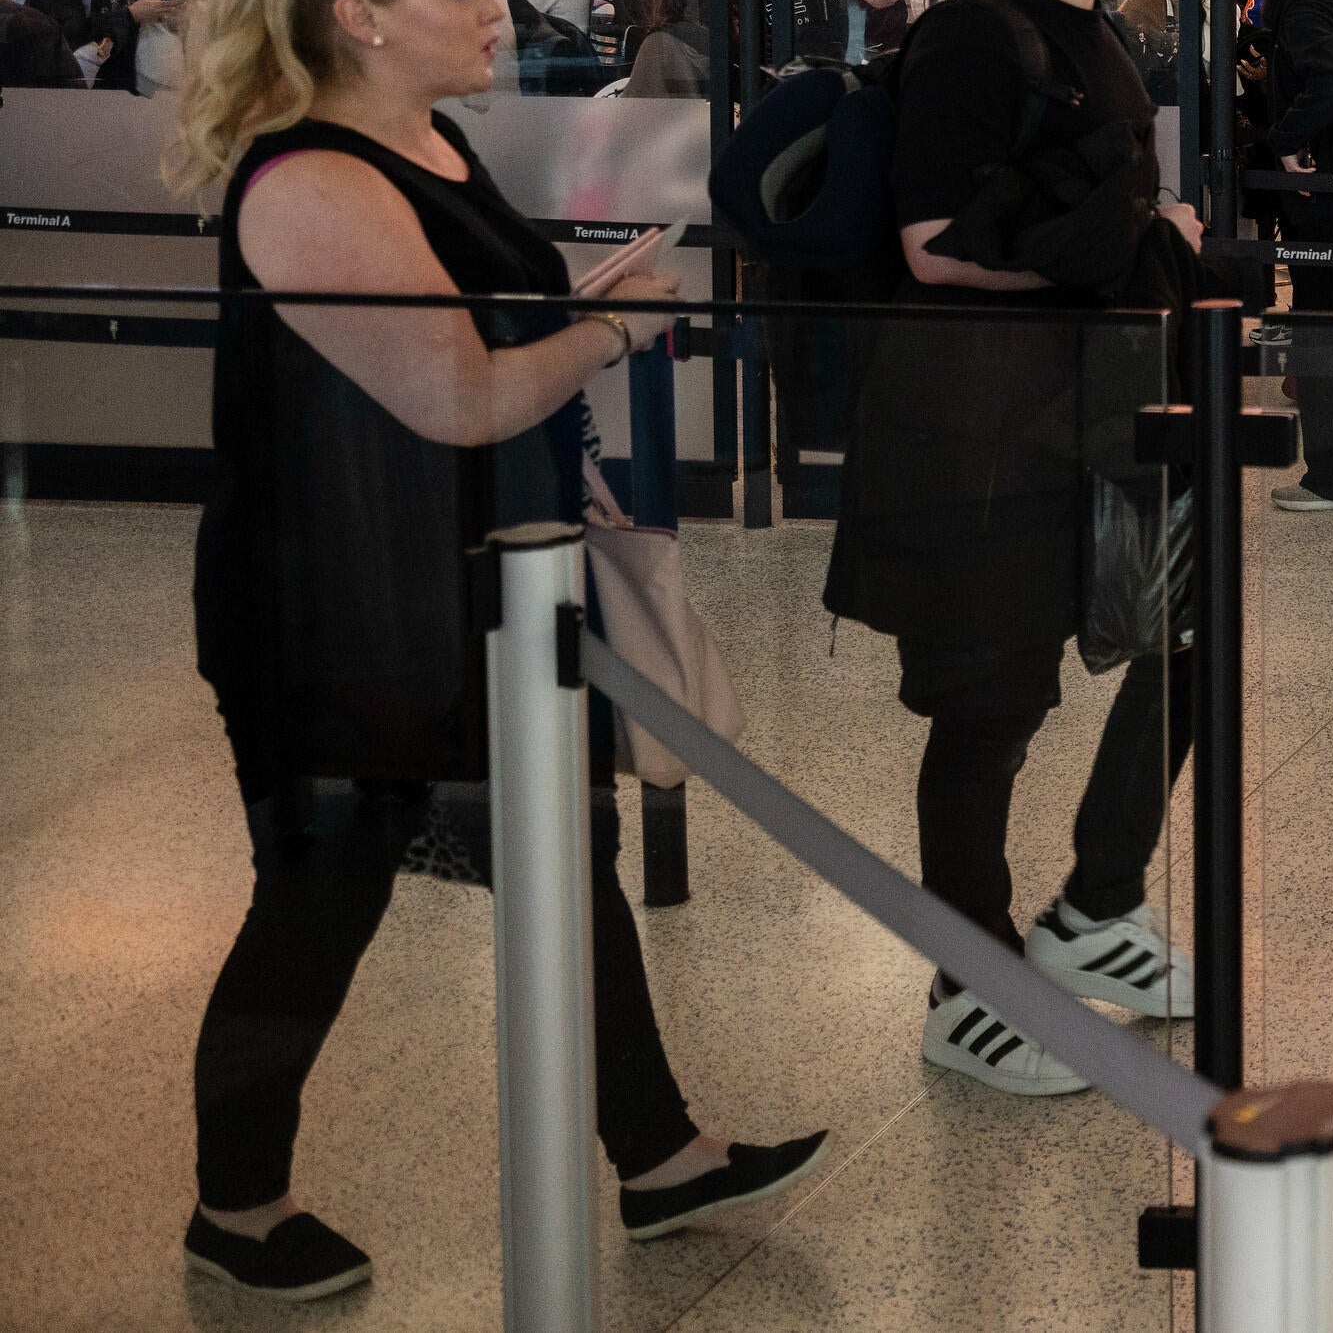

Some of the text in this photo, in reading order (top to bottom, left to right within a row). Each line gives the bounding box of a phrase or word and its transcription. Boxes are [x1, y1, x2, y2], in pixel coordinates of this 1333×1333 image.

[6, 213, 71, 227] Terminal A
[574, 227, 640, 239] Terminal A
[1276, 247, 1331, 260] Terminal
